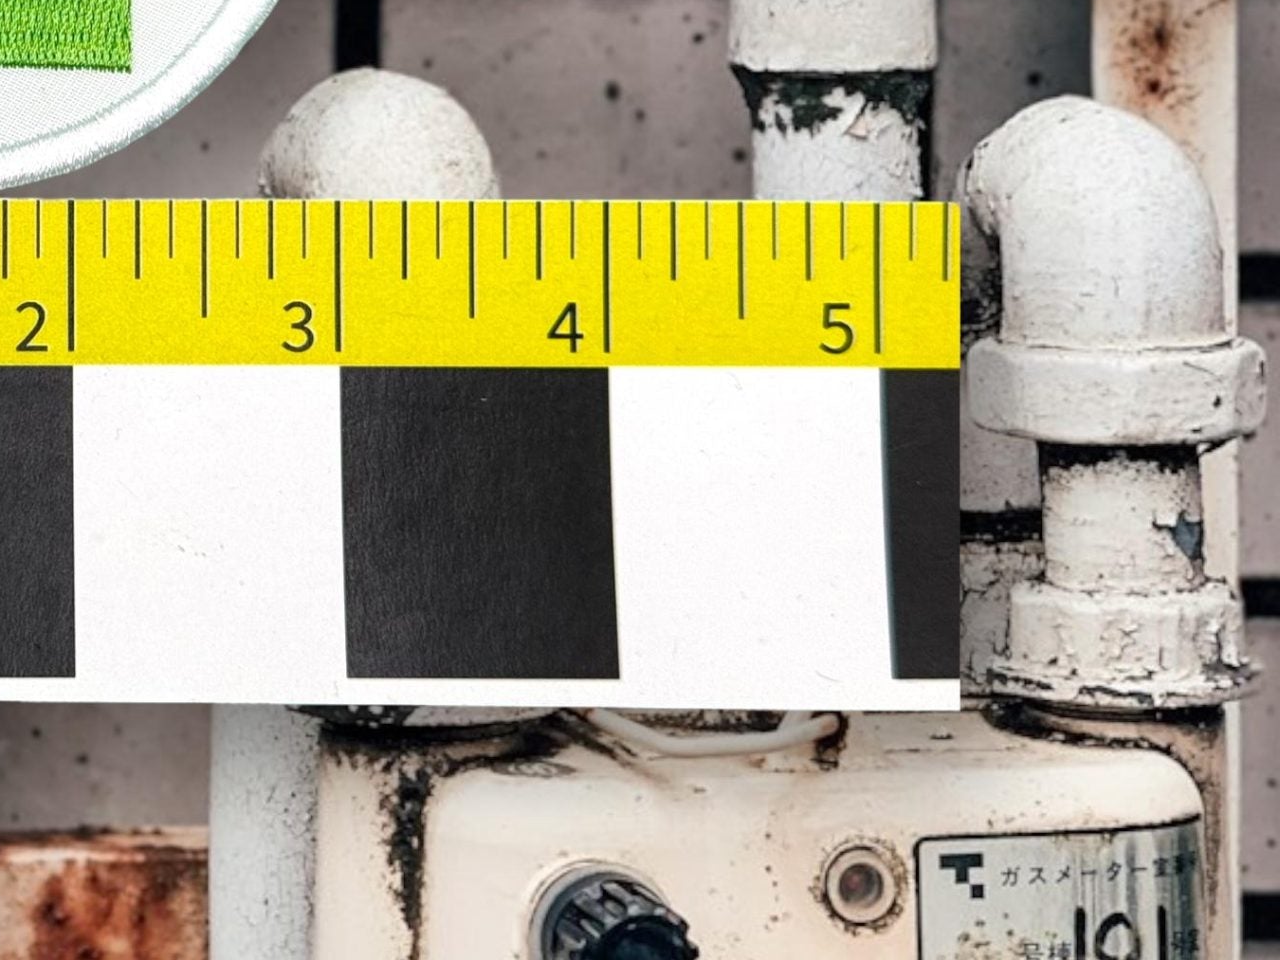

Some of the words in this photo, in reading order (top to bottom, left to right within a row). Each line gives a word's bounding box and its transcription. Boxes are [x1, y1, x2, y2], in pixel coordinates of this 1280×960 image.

[15, 301, 48, 352] 2
[282, 301, 314, 353] 3
[547, 302, 584, 353] 4
[820, 303, 854, 355] 5
